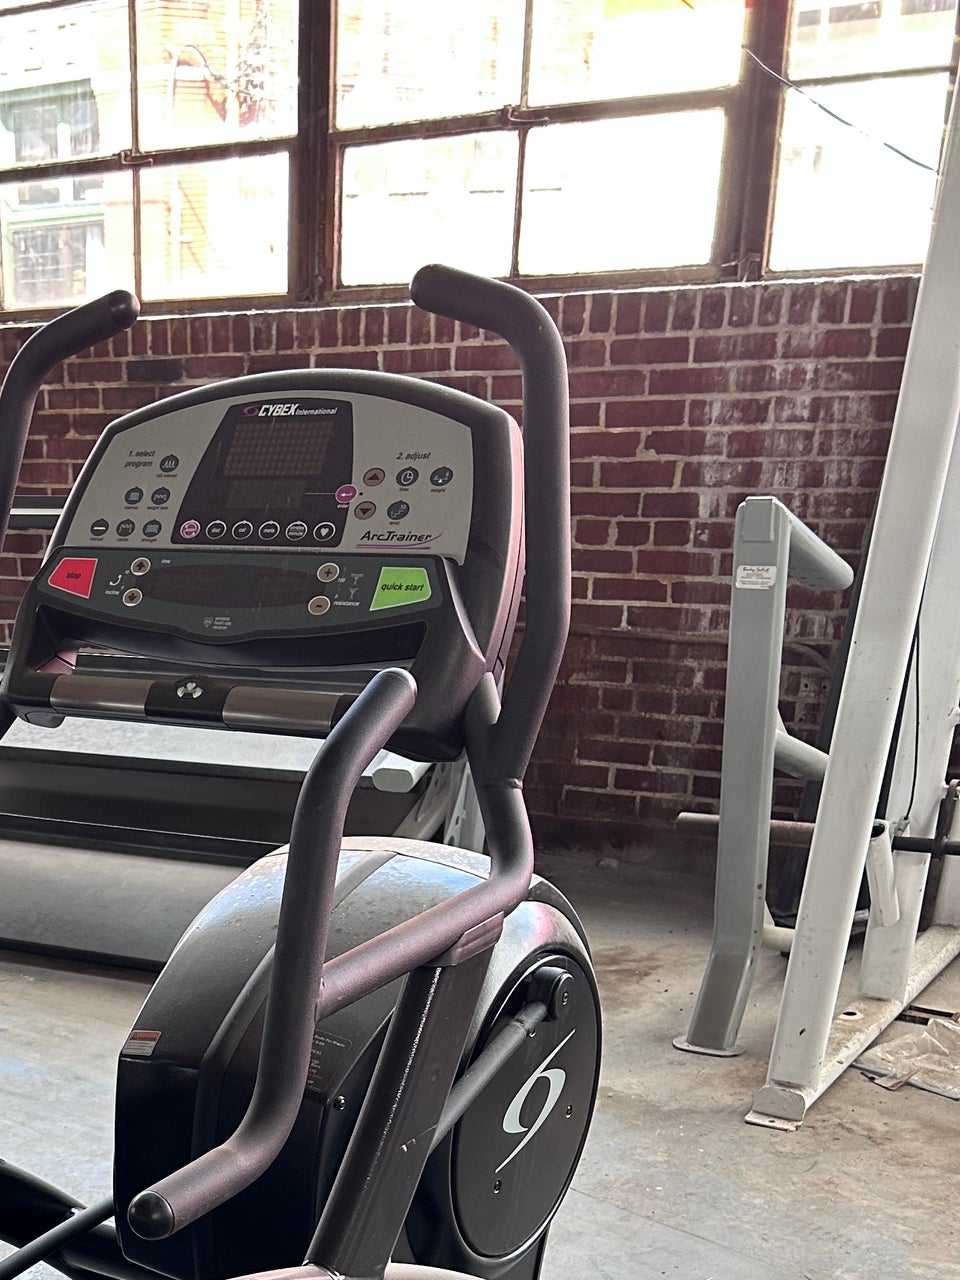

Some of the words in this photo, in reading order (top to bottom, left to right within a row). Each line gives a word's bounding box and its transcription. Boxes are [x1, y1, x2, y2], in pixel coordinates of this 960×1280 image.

[258, 403, 299, 417] CYBEX
[295, 407, 338, 416] International
[405, 452, 431, 461] adjust
[124, 460, 153, 468] program
[360, 531, 433, 542] ArcTrainer
[66, 571, 81, 580] stop
[381, 582, 403, 593] quick
[404, 583, 425, 592] start
